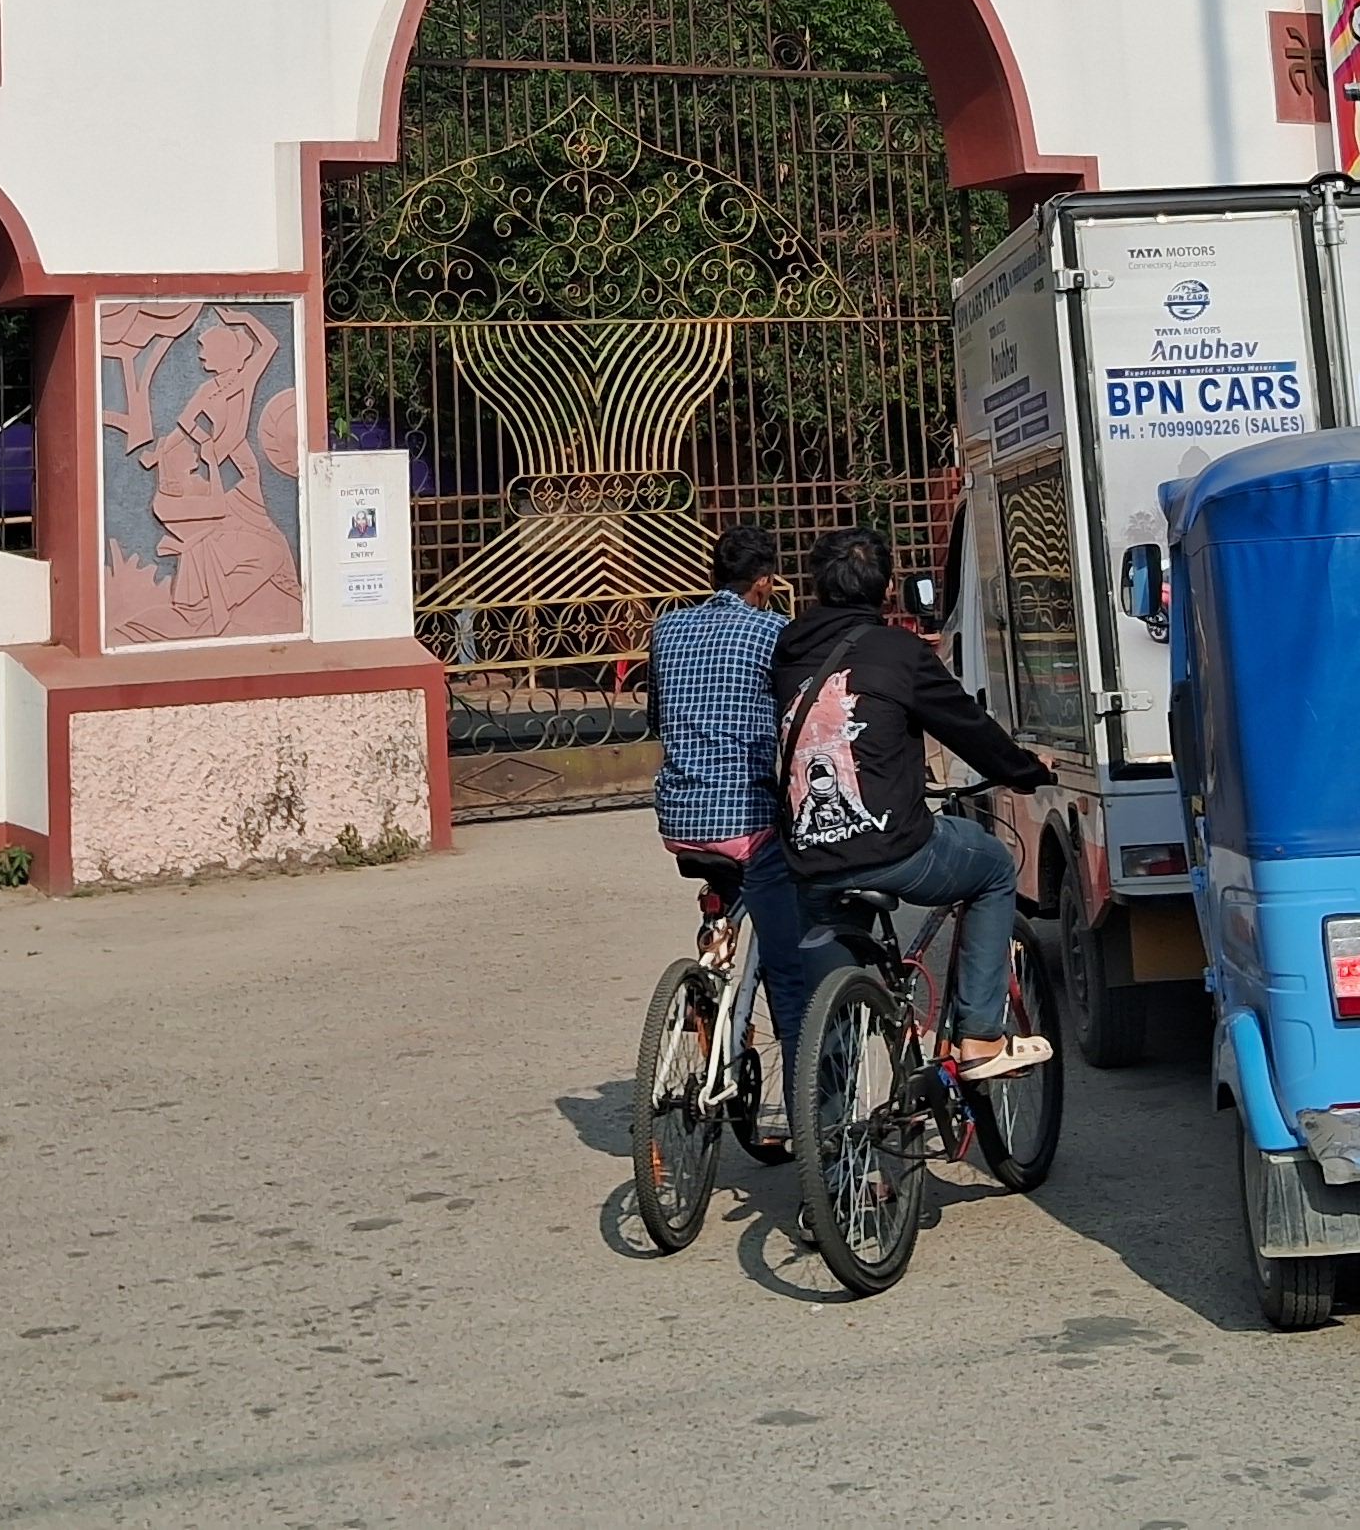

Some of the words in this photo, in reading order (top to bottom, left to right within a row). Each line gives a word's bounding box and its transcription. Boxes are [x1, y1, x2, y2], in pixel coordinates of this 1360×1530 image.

[1127, 248, 1163, 259] TATA
[1166, 246, 1216, 257] MOTORS
[1128, 261, 1172, 270] Connecting
[1173, 260, 1217, 269] Aspirations
[1154, 327, 1181, 336] TATA
[1183, 326, 1221, 336] MOTORS
[1149, 338, 1259, 361] Anubhav
[1106, 378, 1185, 417] BPN
[1198, 374, 1301, 413] CARS
[1149, 420, 1240, 439] 7099909226
[1245, 414, 1305, 436] (SALES)
[340, 487, 381, 497] DICTATOR
[356, 541, 368, 549] NO
[350, 550, 375, 559] ENTRY
